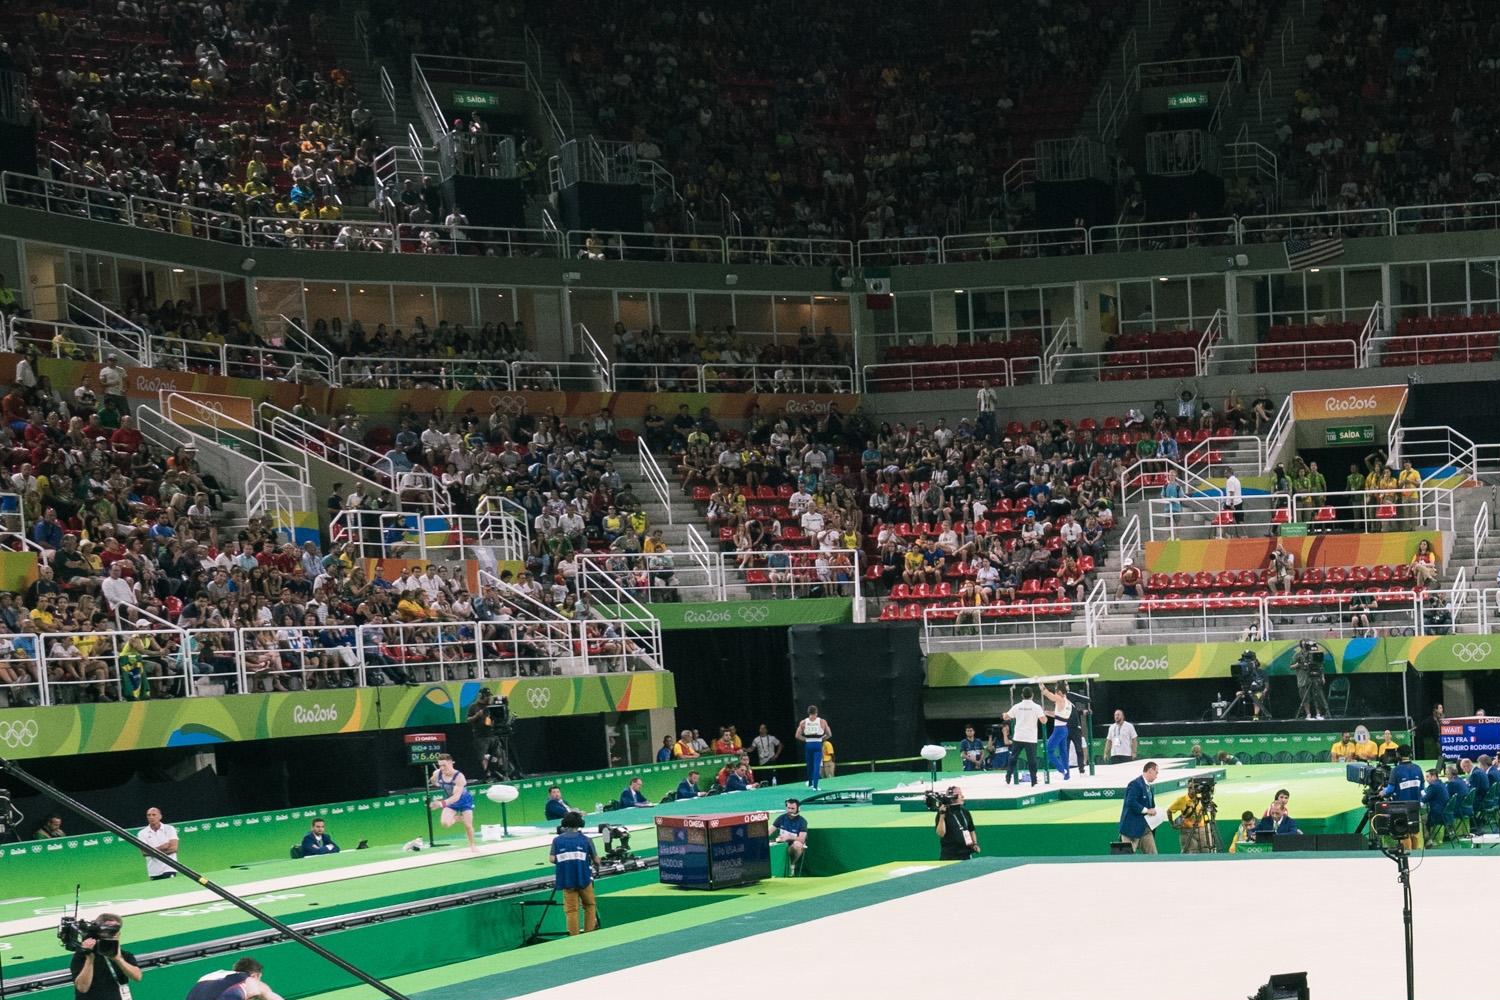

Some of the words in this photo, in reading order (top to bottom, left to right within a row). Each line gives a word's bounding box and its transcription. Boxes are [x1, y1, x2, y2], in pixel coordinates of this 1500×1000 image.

[1326, 395, 1376, 411] Rio2016
[1340, 430, 1360, 438] SAÍDA
[684, 610, 732, 623] Rio2016
[1114, 655, 1169, 671] Rio2016
[294, 704, 338, 724] Rio2016
[751, 813, 768, 822] OMEGA
